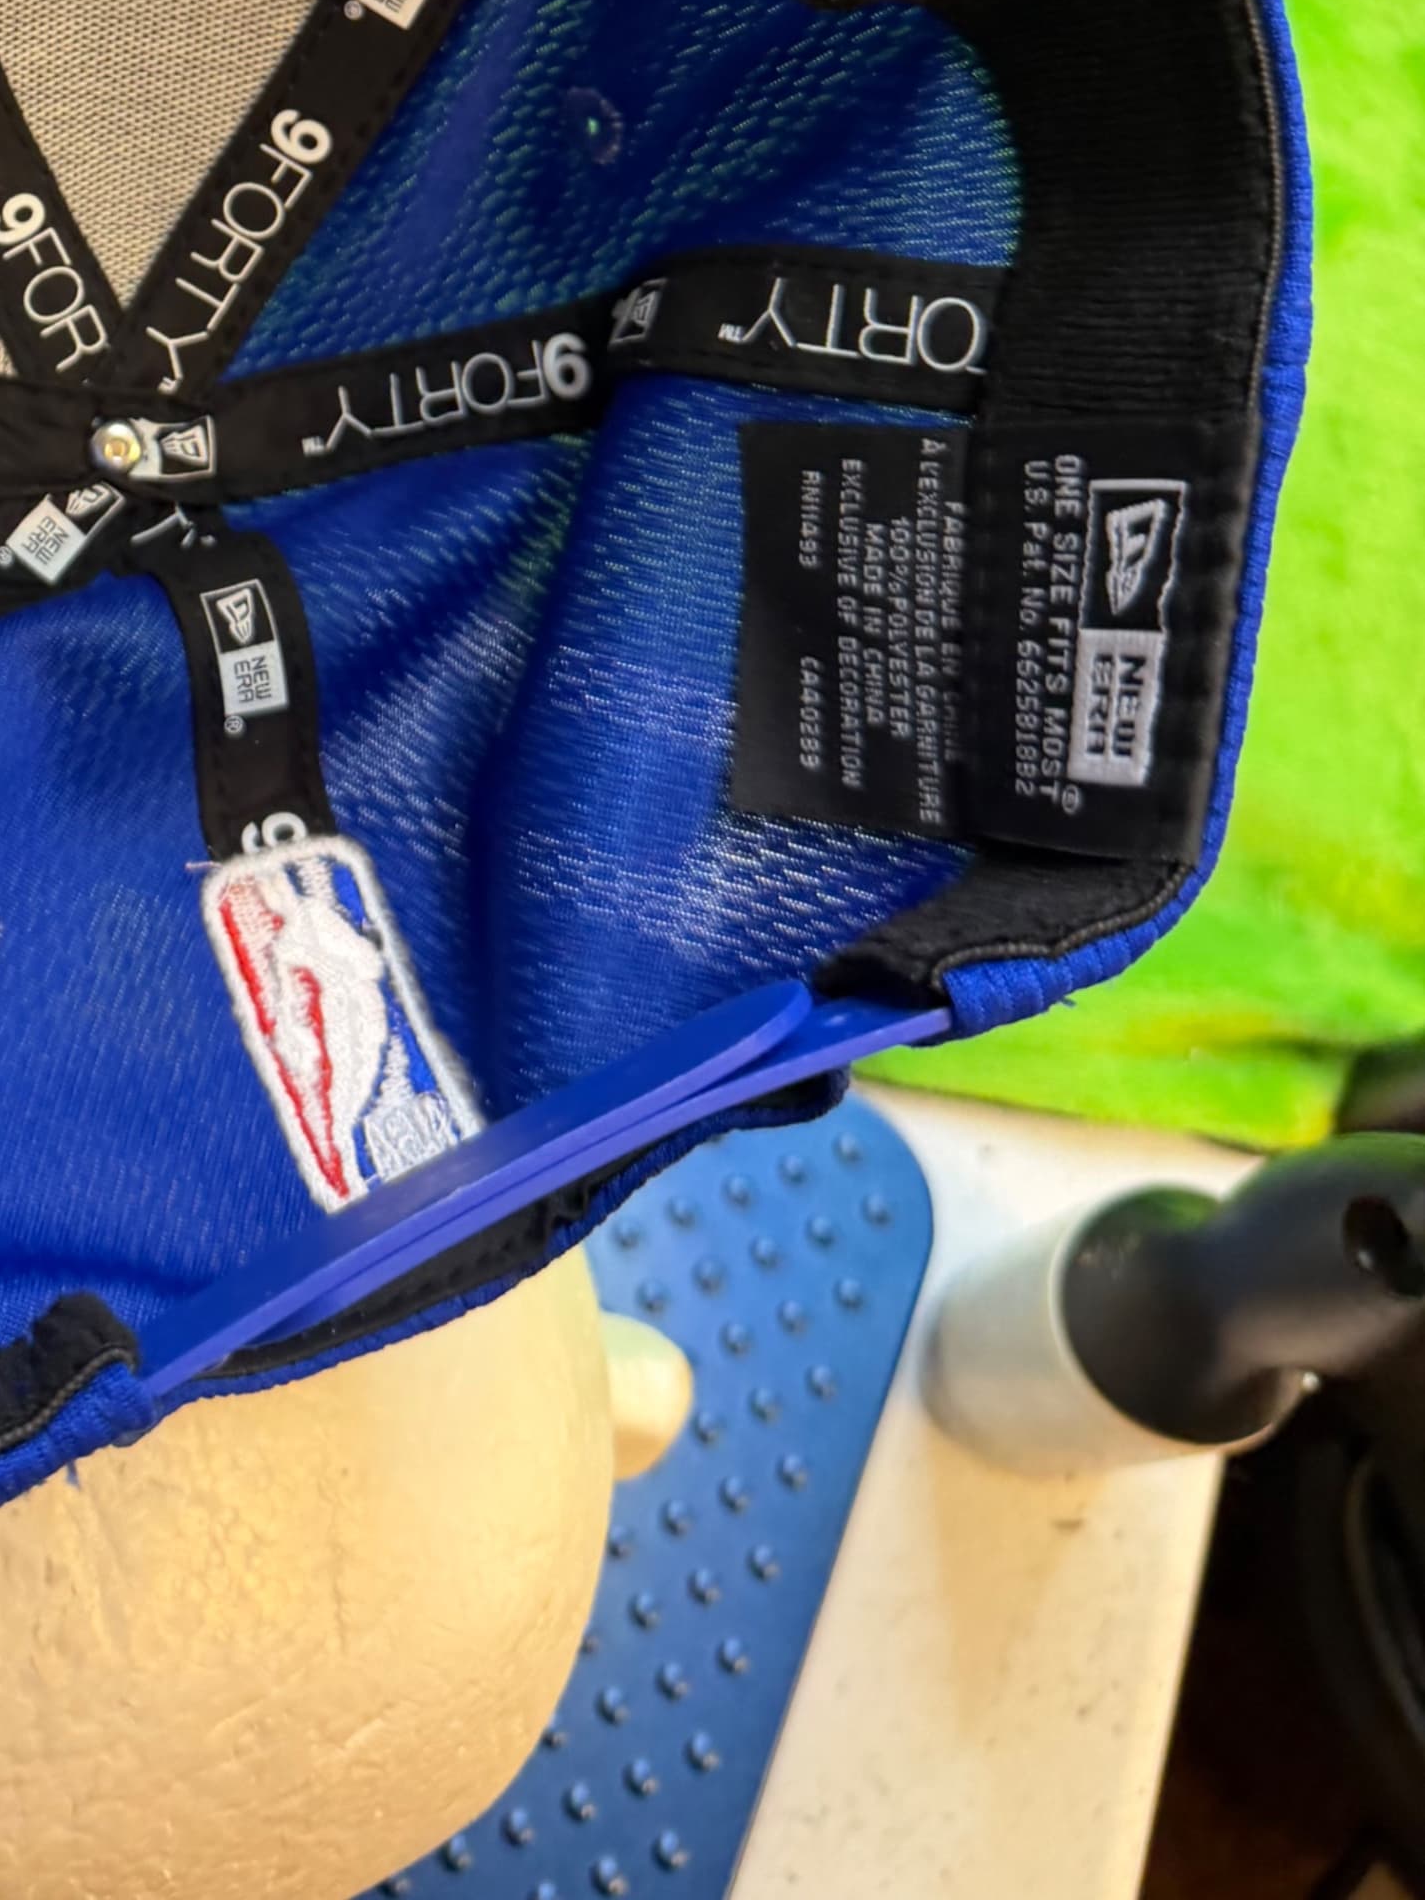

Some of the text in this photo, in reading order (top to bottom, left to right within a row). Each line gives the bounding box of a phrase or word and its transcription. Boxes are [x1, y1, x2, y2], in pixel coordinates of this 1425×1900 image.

[21, 515, 57, 554] ERA
[35, 525, 70, 566] NEW
[1022, 521, 1050, 576] Pat.
[938, 500, 966, 629] FABRIQUE
[837, 458, 863, 789] EXCLUSIVE OF DECORATION
[863, 522, 885, 726] MADE IN CHINA
[915, 608, 936, 641] DE
[1019, 587, 1045, 631] No.
[1039, 454, 1082, 803] ONE SIZE FITS MOST
[233, 659, 255, 704] ERA
[251, 654, 273, 700] NEW
[888, 596, 913, 740] POLYESTER
[914, 645, 937, 678] LA
[941, 641, 962, 677] EN
[1086, 652, 1114, 755] ERA
[1112, 653, 1147, 757] NEW
[915, 683, 943, 825] GARNITURE
